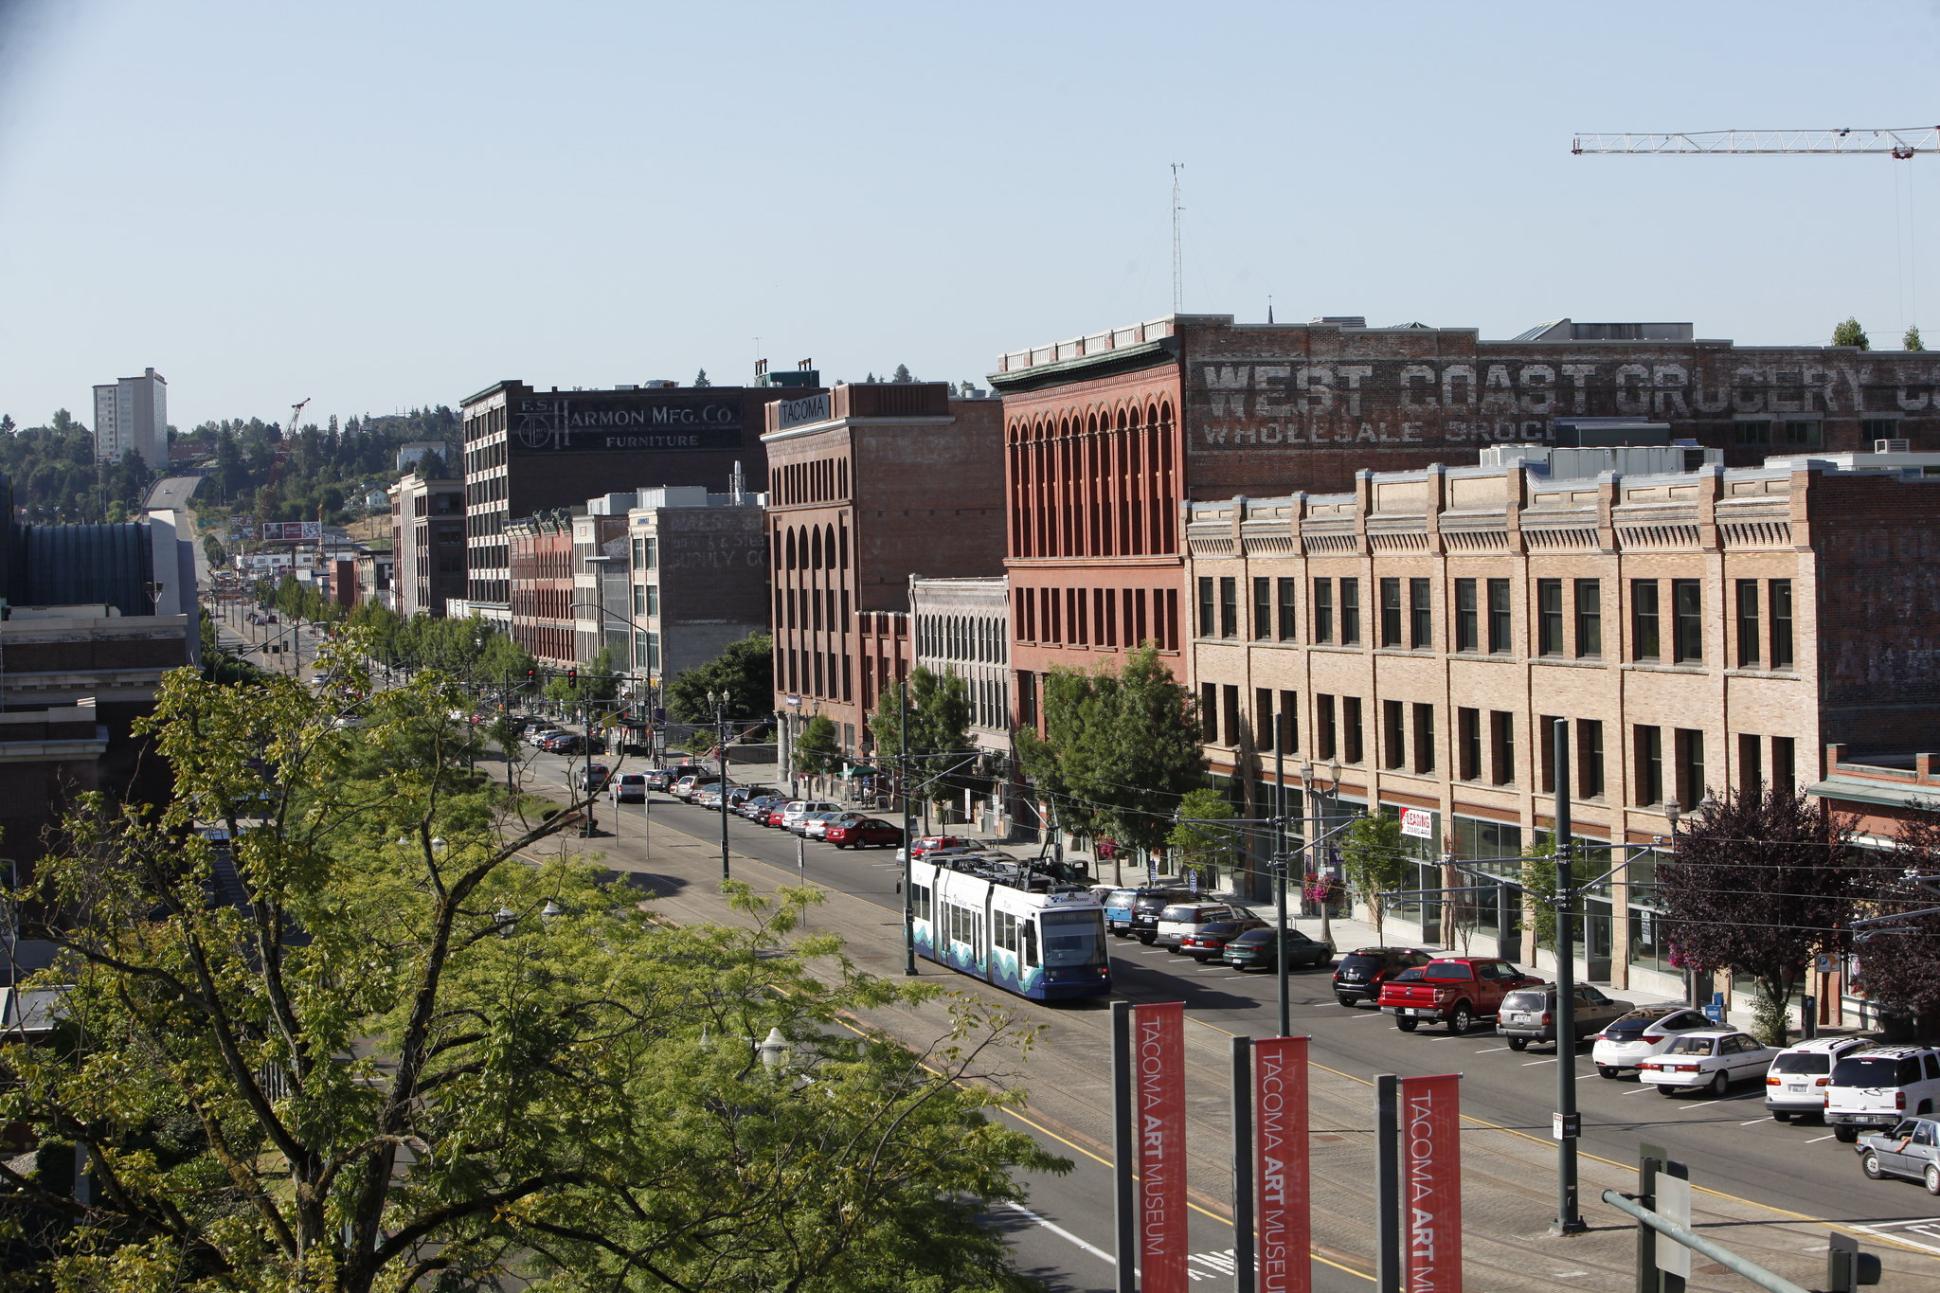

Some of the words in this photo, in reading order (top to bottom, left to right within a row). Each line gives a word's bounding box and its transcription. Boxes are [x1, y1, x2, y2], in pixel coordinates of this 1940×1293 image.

[782, 396, 825, 424] TACOMA
[1203, 365, 1373, 419] WEST
[1399, 363, 1597, 415] COAST
[606, 434, 700, 448] FURNITURE
[1142, 1015, 1161, 1111] TACOMA
[1263, 1048, 1284, 1151] TACOMA
[1144, 1114, 1162, 1159] ART
[1410, 1089, 1433, 1202] TACOMA
[1264, 1156, 1285, 1205] ART
[1145, 1163, 1165, 1256] MUSEUM
[1412, 1207, 1434, 1262] ART
[1265, 1209, 1286, 1293] MUSEU
